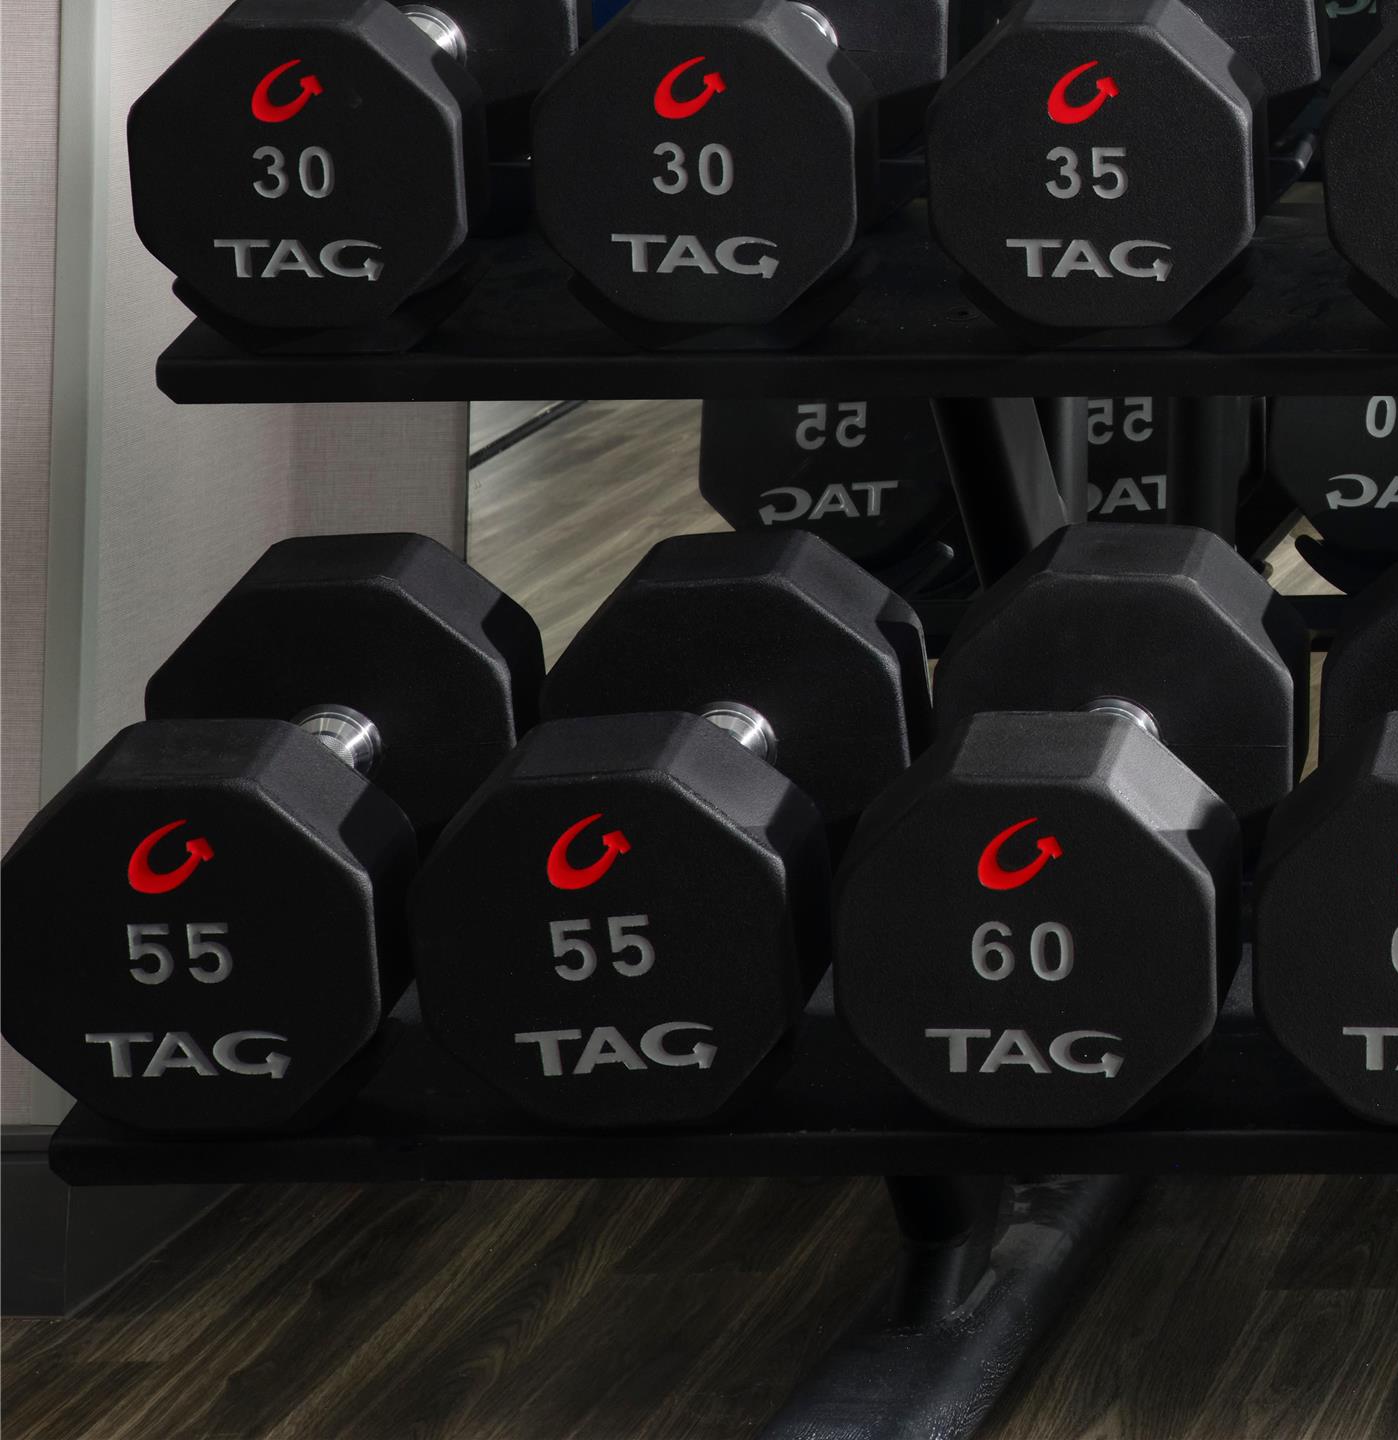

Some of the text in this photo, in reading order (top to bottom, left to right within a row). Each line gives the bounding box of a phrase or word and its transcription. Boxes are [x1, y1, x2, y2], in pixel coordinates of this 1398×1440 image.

[251, 144, 333, 200] 30
[651, 140, 734, 197] 30
[1044, 145, 1127, 201] 35
[212, 238, 379, 283] TAG
[609, 232, 780, 280] TAG
[1004, 237, 1171, 283] TAG
[125, 922, 232, 986] 55
[548, 913, 656, 983] 55
[970, 920, 1073, 983] 60
[83, 1030, 289, 1080] TAG
[513, 1020, 717, 1078] TAG
[924, 1027, 1123, 1080] TAG
